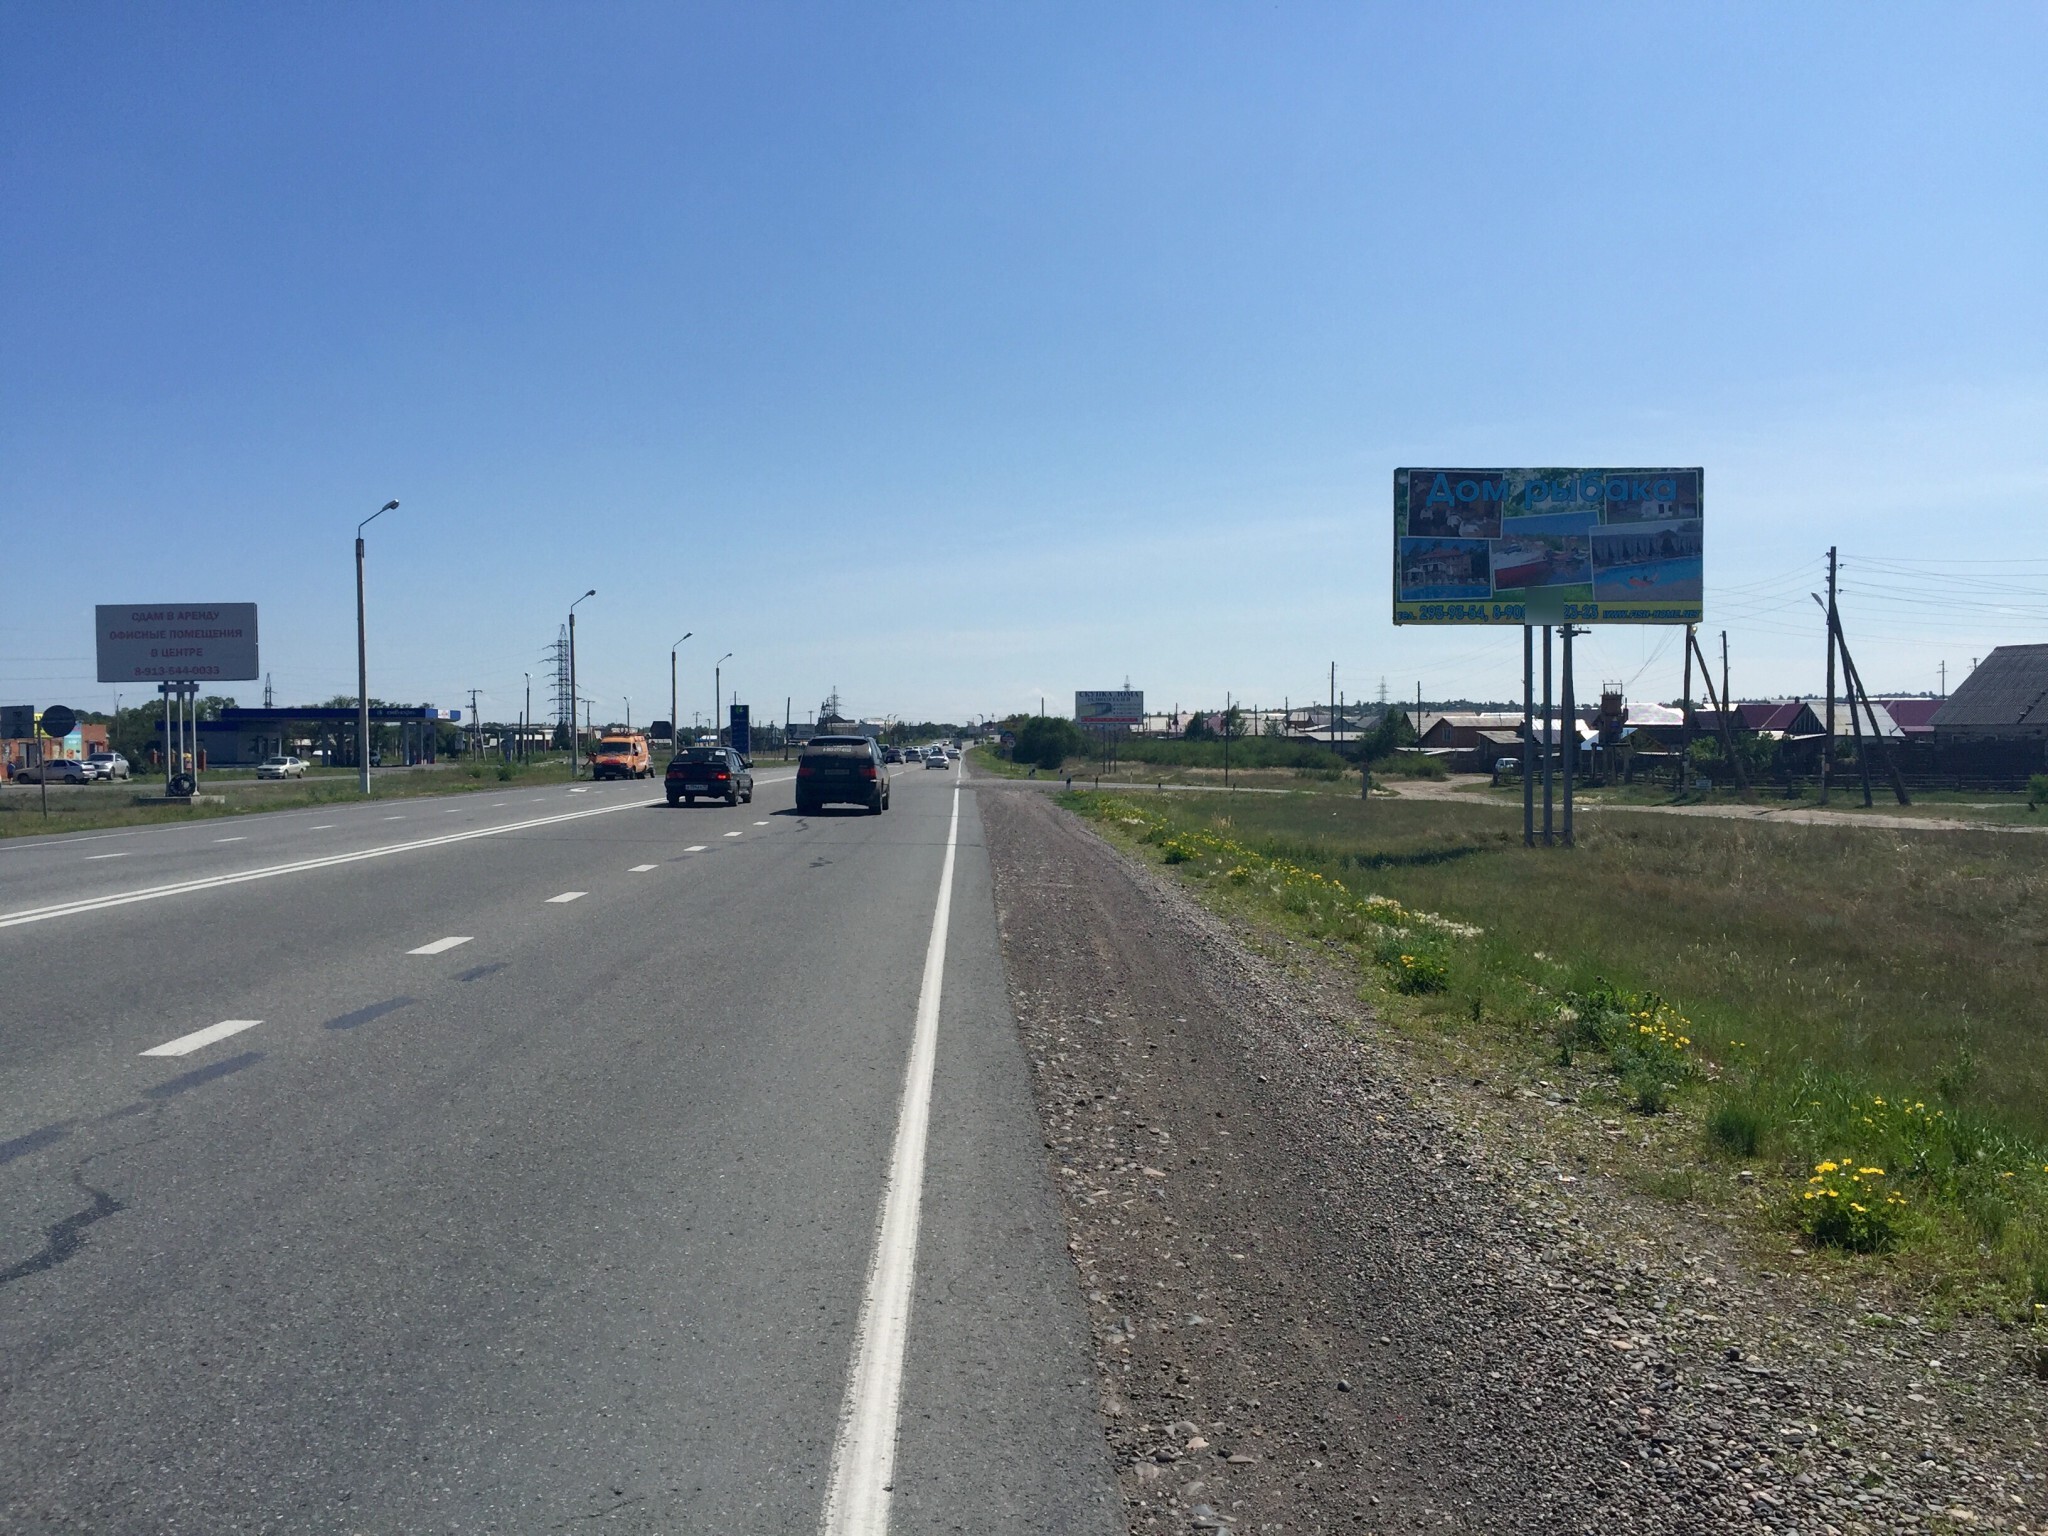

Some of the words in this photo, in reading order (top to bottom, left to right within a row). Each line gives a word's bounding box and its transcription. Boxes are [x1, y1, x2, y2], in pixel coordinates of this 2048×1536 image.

[1426, 471, 1509, 507] Дом
[1523, 470, 1677, 510] рыбака
[131, 611, 164, 622] СДАМ
[167, 611, 174, 621] В
[177, 610, 220, 622] АРЕНДУ
[1396, 610, 1417, 621] тел.
[109, 630, 166, 641] ОФИСНЫЕ
[169, 628, 243, 640] ПОМЕЩЕНИЯ
[150, 647, 158, 658] В
[161, 647, 204, 658] ЦЕНТРЕ
